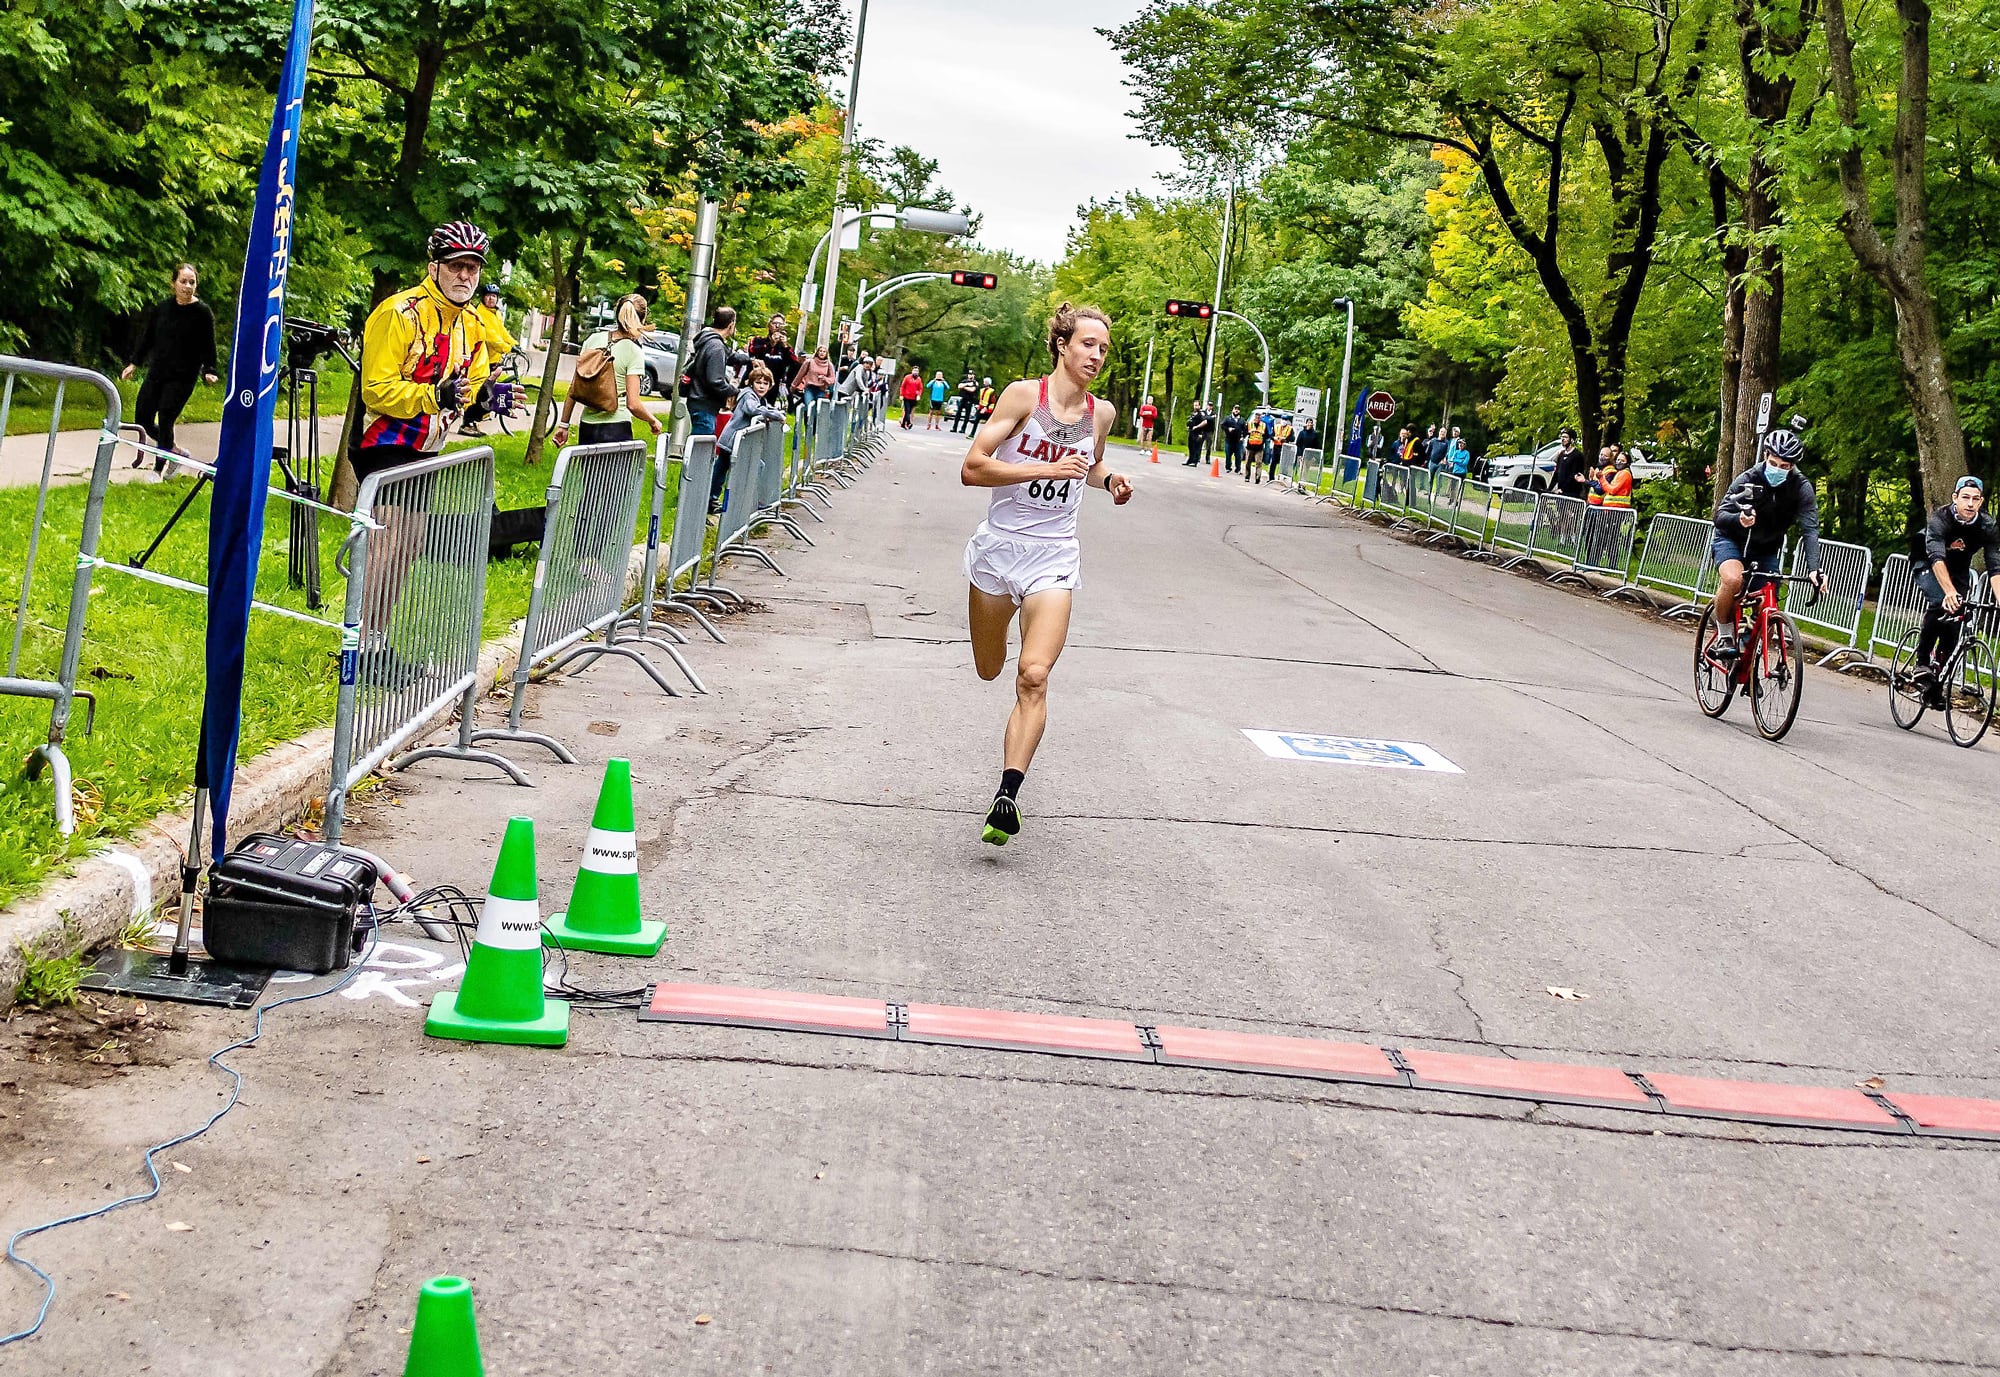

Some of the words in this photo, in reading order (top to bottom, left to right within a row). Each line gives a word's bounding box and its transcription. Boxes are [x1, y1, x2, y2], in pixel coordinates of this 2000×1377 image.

[1368, 401, 1394, 412] ARRÊT
[1017, 433, 1088, 463] LAV
[1028, 479, 1071, 503] 664
